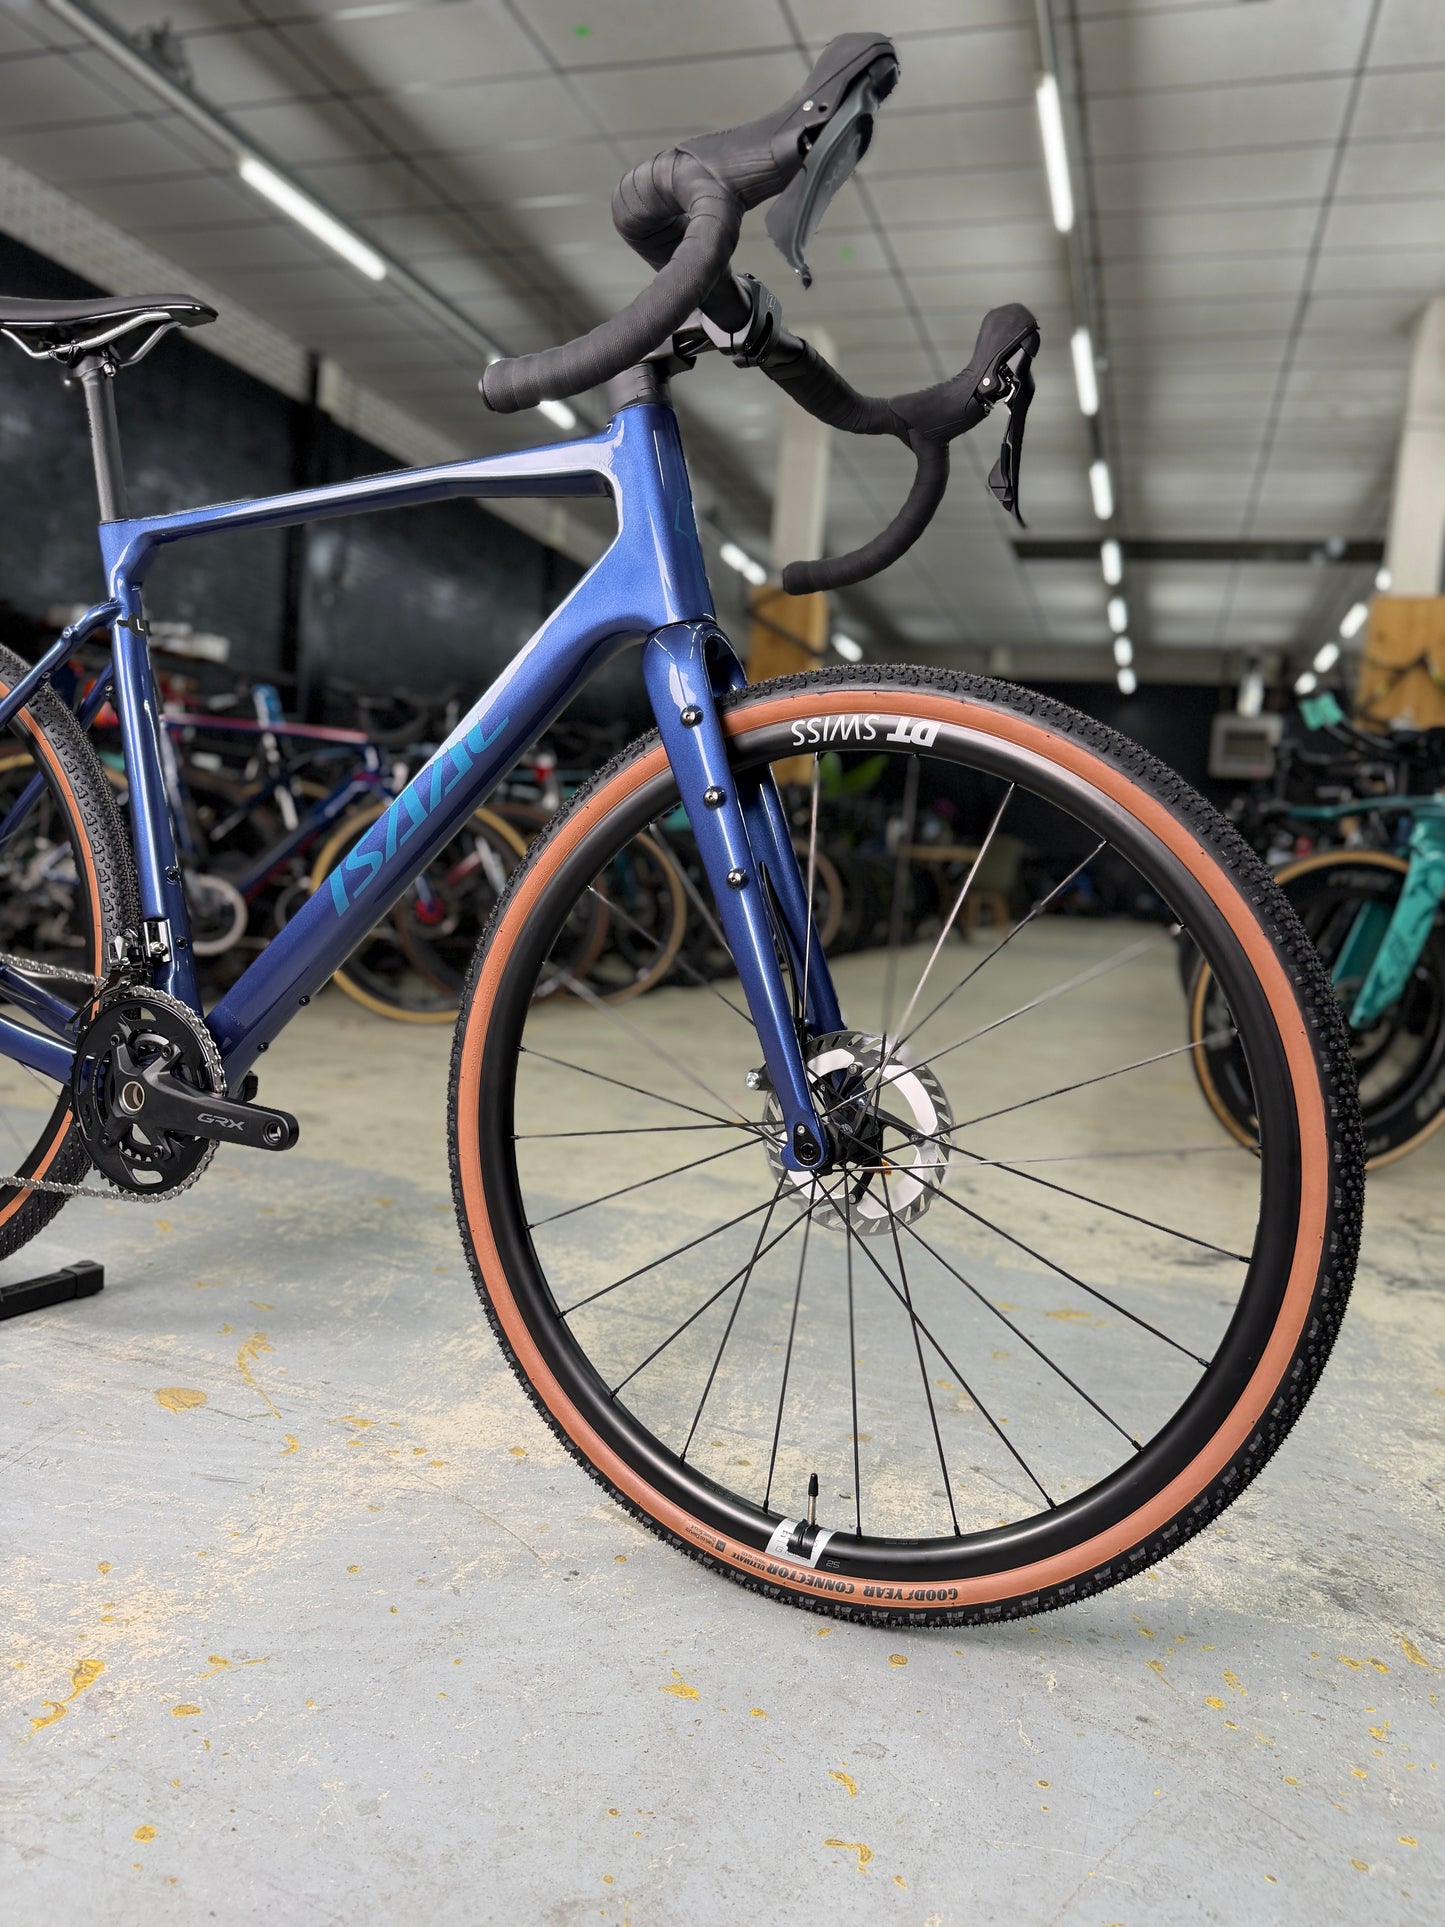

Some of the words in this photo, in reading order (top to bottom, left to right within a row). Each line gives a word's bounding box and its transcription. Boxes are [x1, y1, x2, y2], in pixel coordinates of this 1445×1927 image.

[136, 618, 145, 632] L
[791, 714, 881, 747] SWISS
[886, 716, 942, 748] DT
[329, 716, 510, 918] ISAAC
[196, 1112, 246, 1132] GRX
[731, 1552, 766, 1572] ULTIMATE
[766, 1562, 856, 1595] CONNECTOR
[863, 1585, 959, 1603] GOODYEAR
